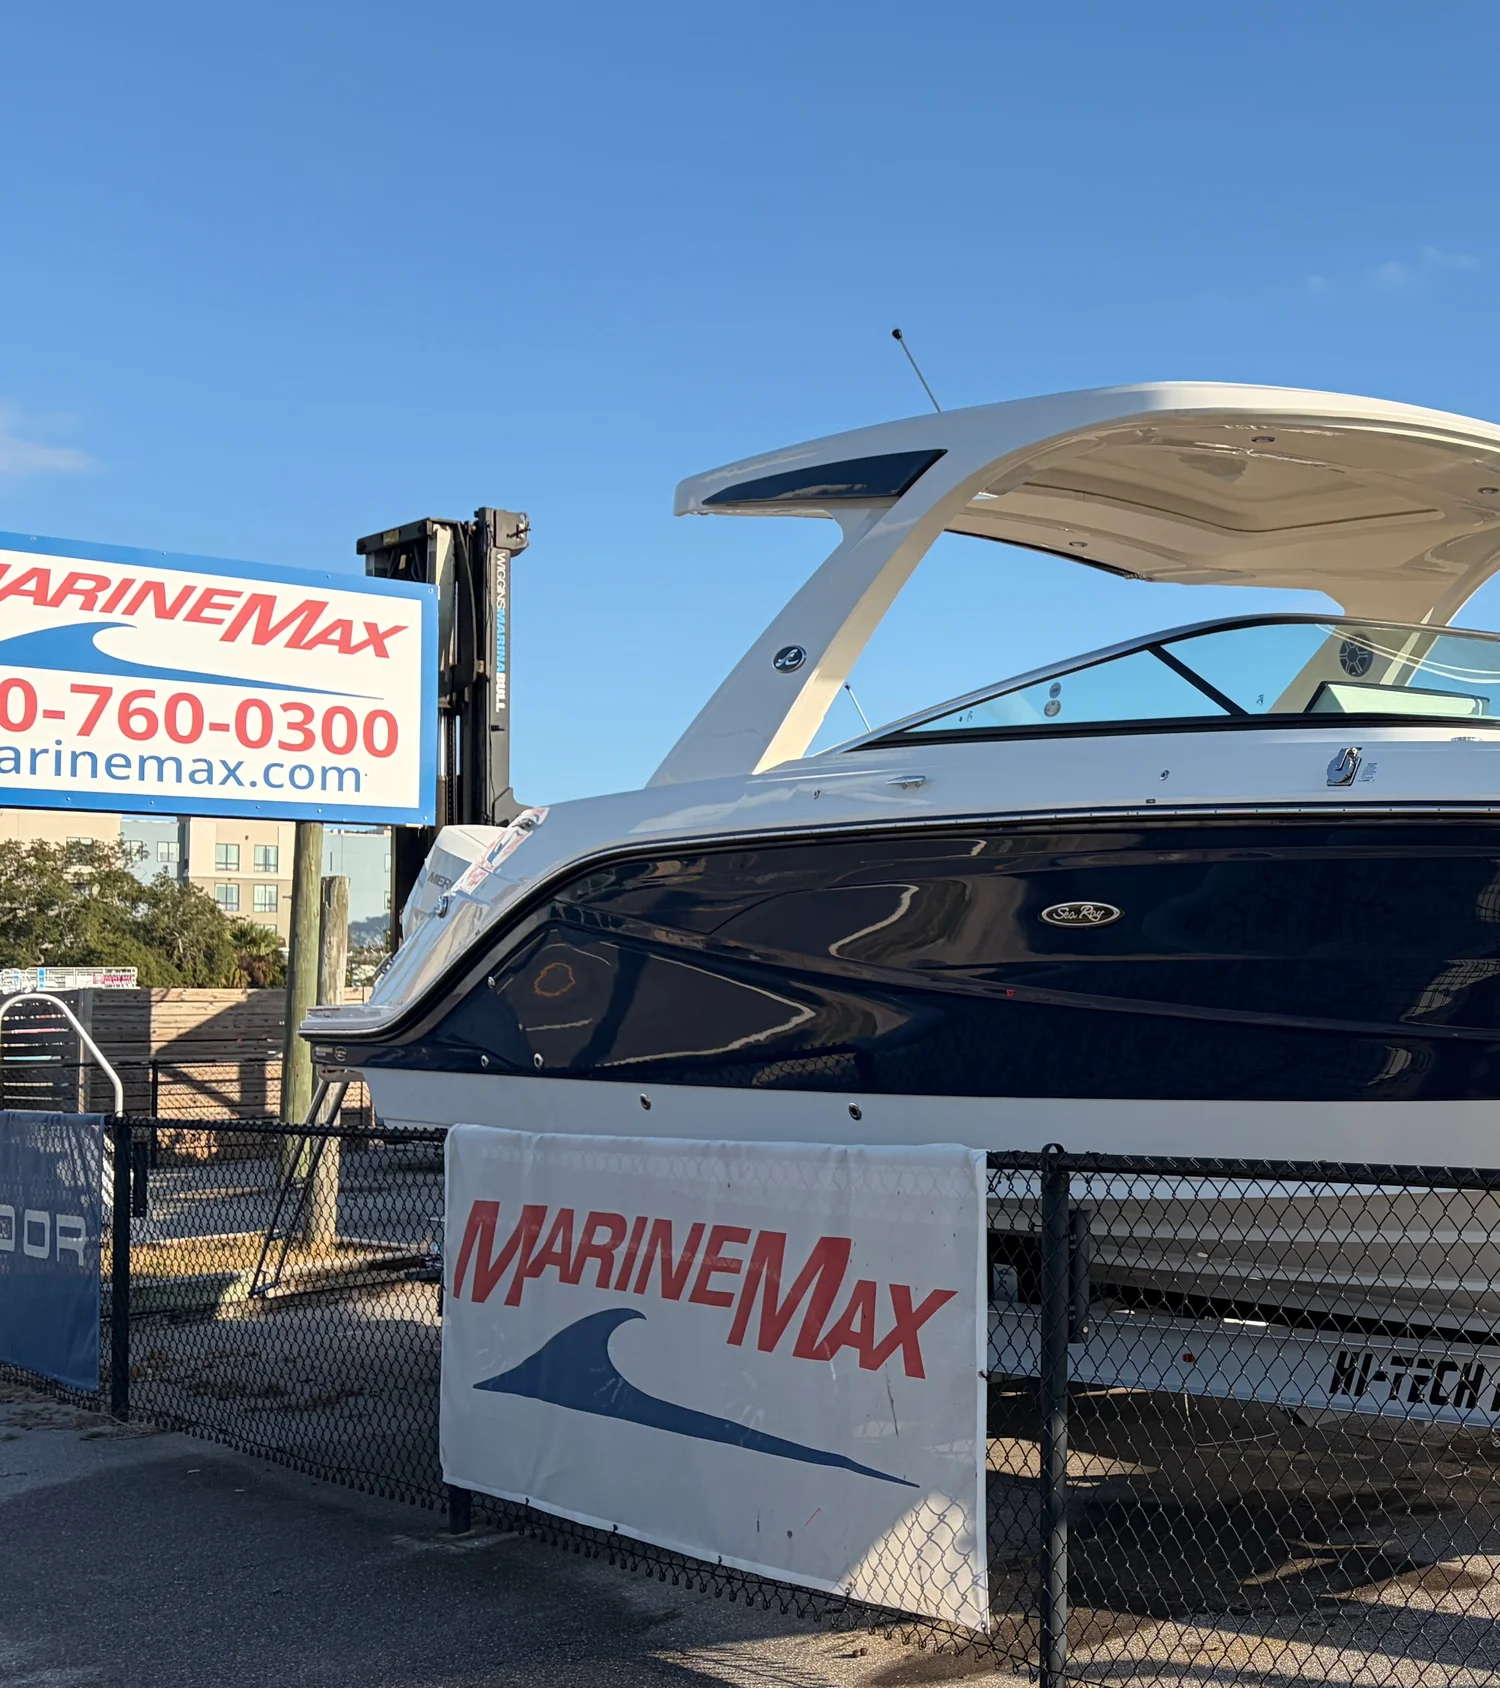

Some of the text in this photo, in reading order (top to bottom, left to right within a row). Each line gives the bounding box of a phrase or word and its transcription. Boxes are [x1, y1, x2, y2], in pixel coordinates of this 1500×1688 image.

[0, 678, 399, 758] 0-760-0300
[1052, 904, 1105, 922] Sea Ray
[1329, 1351, 1486, 1409] HI-TECH
